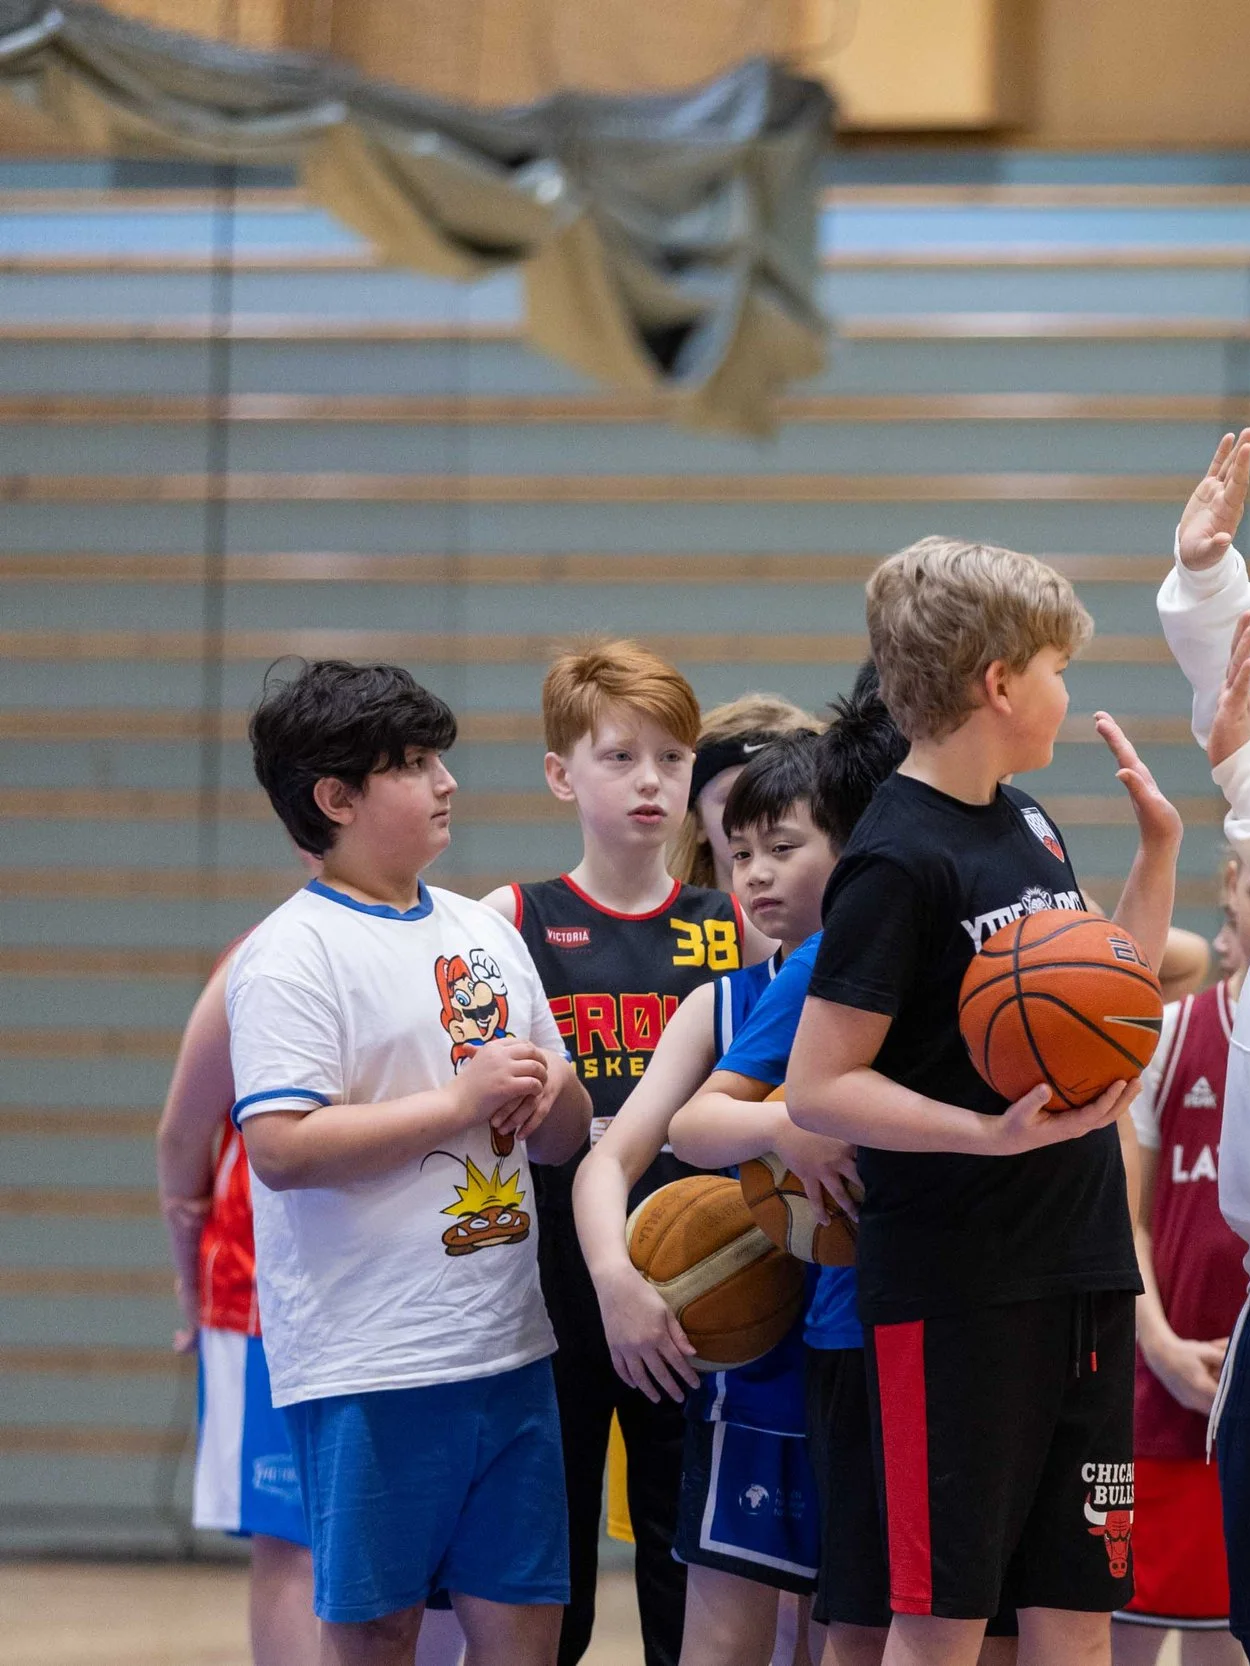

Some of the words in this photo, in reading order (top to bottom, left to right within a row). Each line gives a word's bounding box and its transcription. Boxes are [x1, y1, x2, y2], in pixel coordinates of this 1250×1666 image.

[547, 928, 590, 943] VICTORIA
[670, 918, 740, 970] 38
[571, 1056, 644, 1078] SKE
[1172, 1144, 1220, 1182] LA
[1081, 1462, 1134, 1483] CHICA
